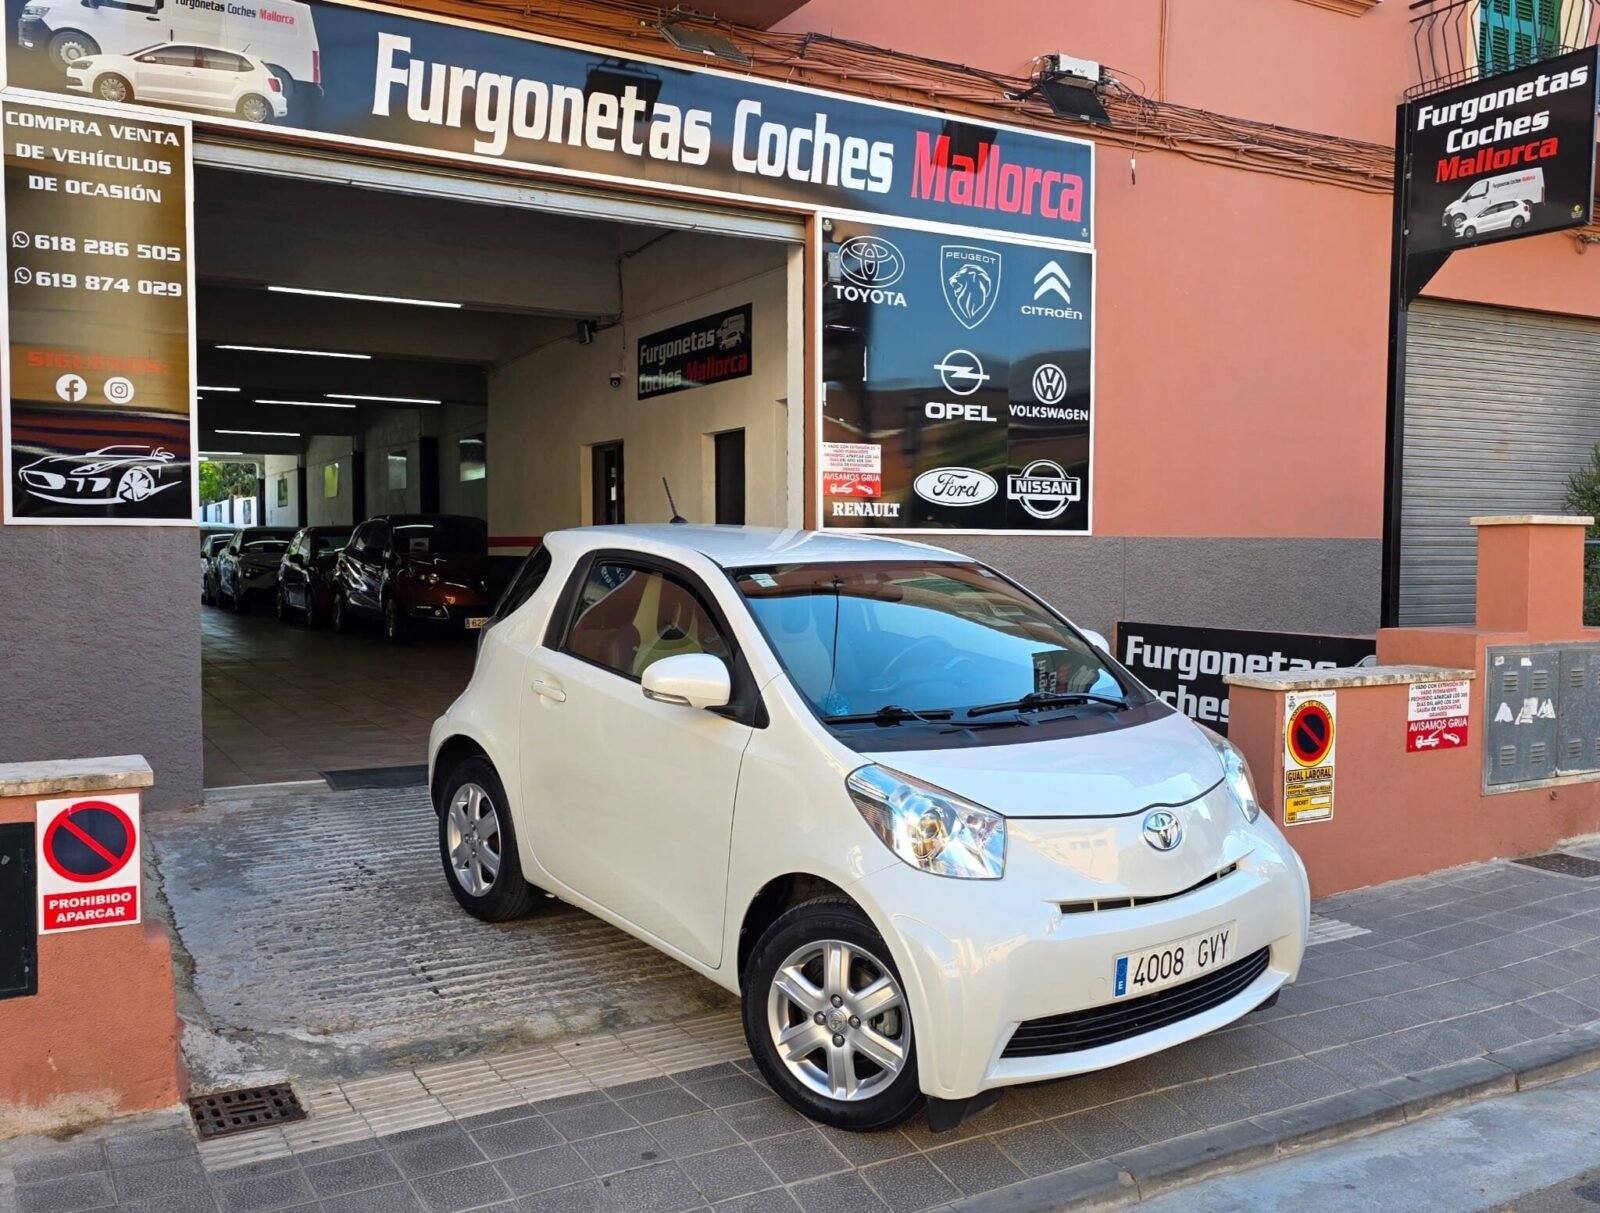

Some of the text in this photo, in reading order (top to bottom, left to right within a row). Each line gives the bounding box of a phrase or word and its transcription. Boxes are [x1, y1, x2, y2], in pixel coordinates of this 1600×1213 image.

[227, 3, 257, 18] Coches
[259, 9, 295, 25] Mallorca
[1417, 65, 1589, 131] Furgonetas
[5, 111, 180, 147] COMPRA VENTA
[371, 31, 1084, 223] Furgonetas Coches Mallorca
[1446, 110, 1550, 154] Coches
[15, 143, 172, 175] DE VEHÍCULOS
[1435, 137, 1559, 183] Mallorca
[28, 175, 162, 204] DE OCASIÓN
[34, 234, 181, 262] 618 286 505
[945, 251, 997, 265] PEUGEOT
[35, 271, 182, 297] 619 874 029
[832, 284, 908, 308] TOYOTA
[639, 328, 716, 367] Furgonetas
[639, 353, 748, 394] Coches Mallorca
[924, 401, 998, 422] OPEL
[1008, 403, 1089, 422] VOLKSWAGEN
[823, 472, 881, 482] AVISAMOS GRUA
[932, 472, 980, 498] Ford
[1015, 479, 1073, 495] NISSAN
[831, 501, 900, 517] RENAULT
[1409, 716, 1468, 732] AVISAMOS GRUA
[1287, 767, 1331, 781] GUAL LABORAL
[49, 892, 132, 910] PROHIBIDO
[56, 906, 126, 924] APARCAR
[1133, 930, 1229, 986] 4008 GVY
[1117, 980, 1124, 990] E
